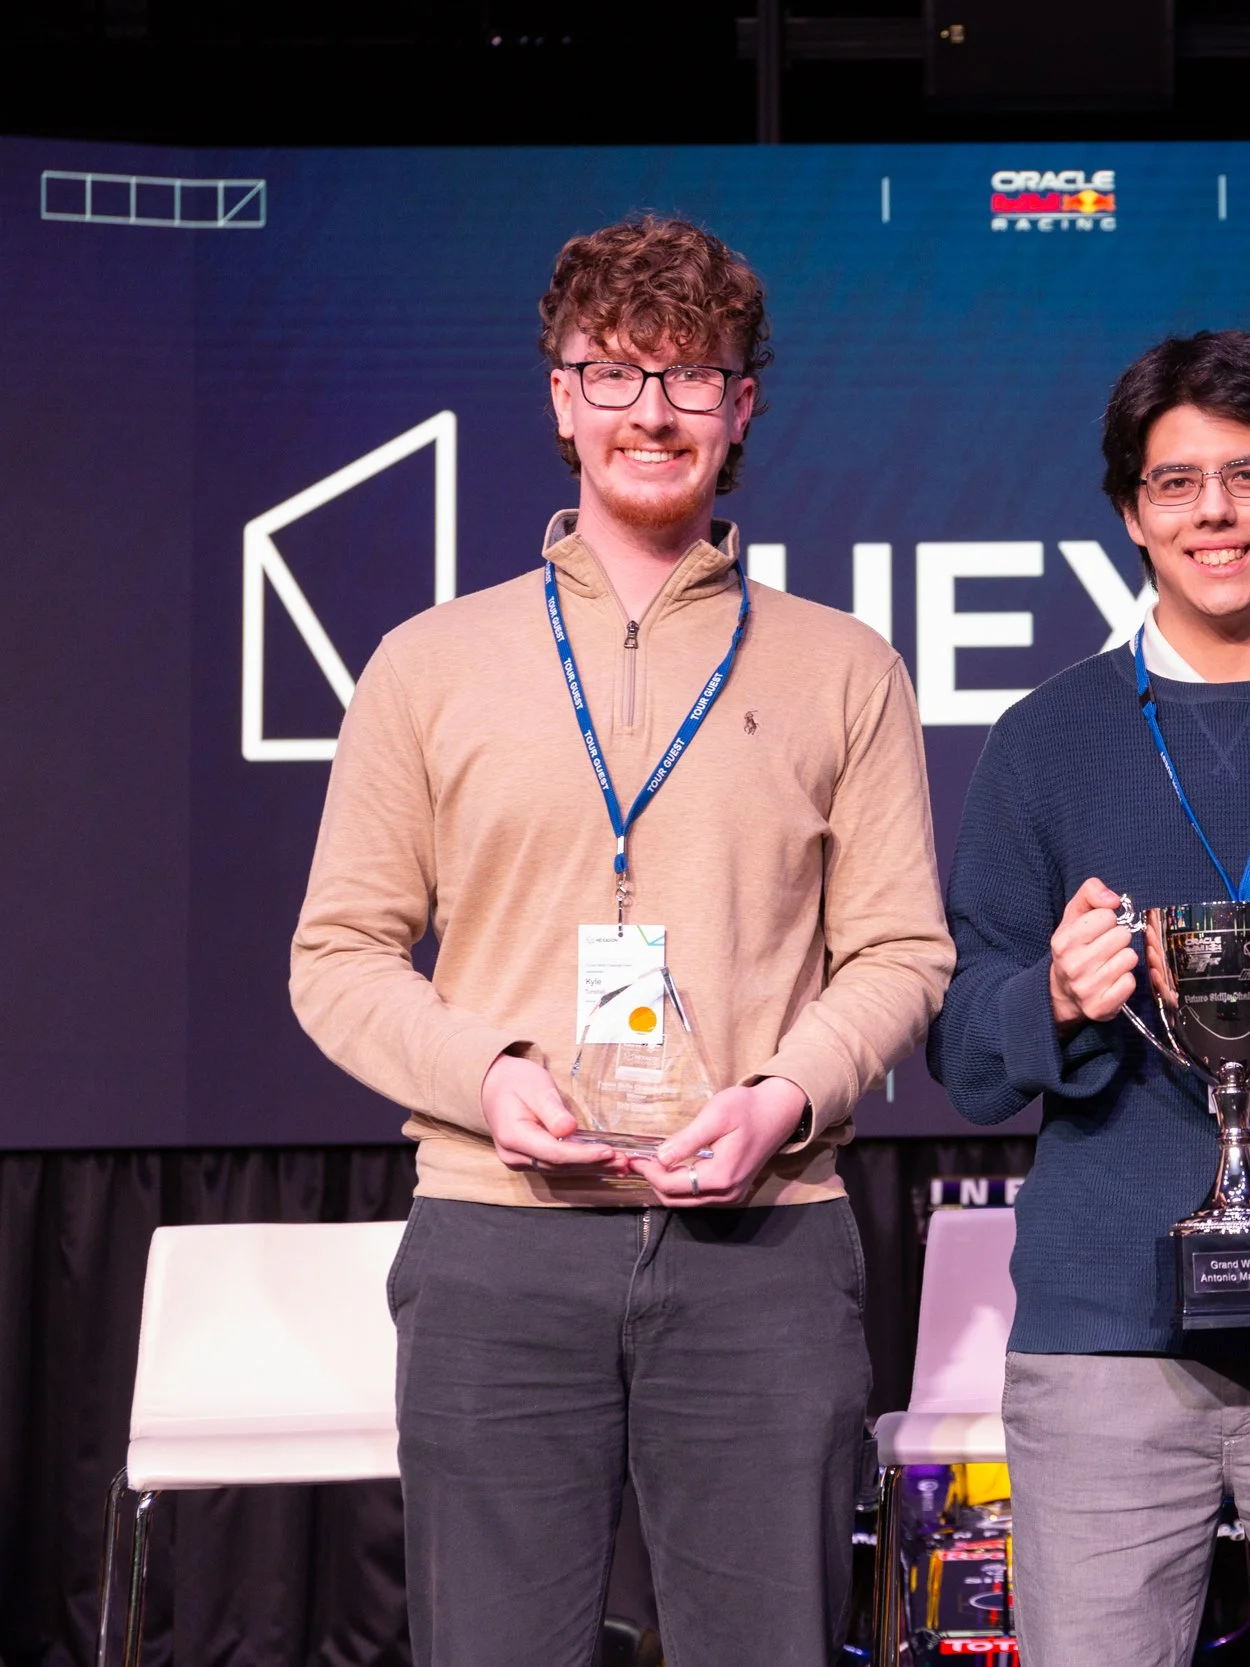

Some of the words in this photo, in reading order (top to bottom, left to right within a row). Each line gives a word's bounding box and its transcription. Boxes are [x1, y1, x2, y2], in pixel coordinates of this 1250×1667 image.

[991, 170, 1115, 192] ORACLE
[991, 217, 1117, 231] RACING
[548, 596, 558, 618] TOUR
[552, 616, 565, 642] GUEST
[564, 657, 575, 683] TOUR
[570, 682, 584, 710] GUEST
[690, 697, 709, 720] TOUR
[703, 672, 723, 697] GUEST
[584, 729, 598, 758] TOUR
[593, 757, 609, 790] GUEST
[646, 767, 667, 793] TOUR
[663, 737, 685, 769] GUEST
[585, 978, 602, 986] Kyle
[1210, 1259, 1239, 1270] Grand
[1200, 1273, 1237, 1283] Antonio
[944, 1639, 1018, 1652] TOT
